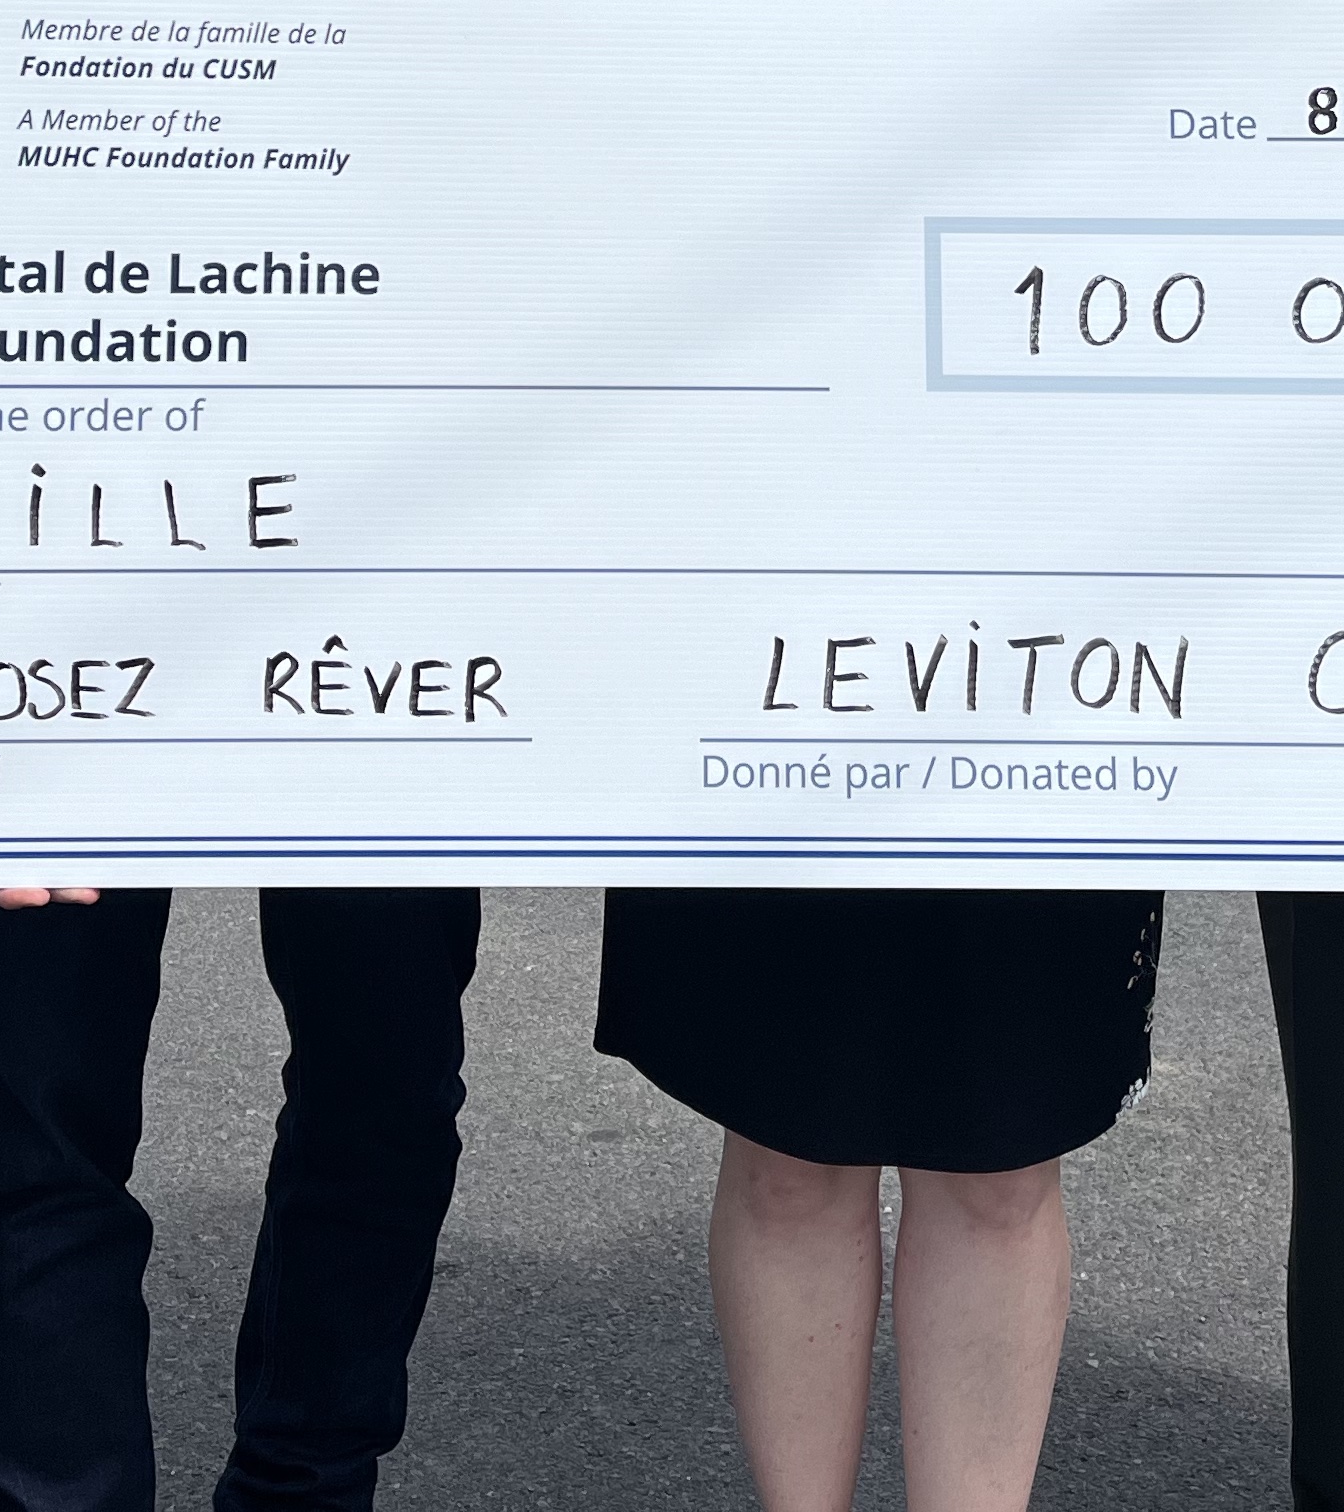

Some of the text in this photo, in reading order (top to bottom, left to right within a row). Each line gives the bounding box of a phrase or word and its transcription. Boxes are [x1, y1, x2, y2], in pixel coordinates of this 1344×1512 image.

[21, 18, 347, 49] Membre de la famille de la
[20, 55, 277, 80] Fondation du CUSM
[16, 108, 222, 138] A Member of the
[1169, 108, 1257, 140] Date
[1308, 86, 1338, 136] 8
[17, 145, 351, 177] MUHC Foundation Family
[84, 250, 150, 294] de
[170, 251, 380, 295] Lachine
[1013, 265, 1206, 356] 100
[43, 397, 153, 432] order
[165, 397, 207, 432] of
[263, 634, 508, 723] RÊVER
[703, 753, 1178, 802] Donné par / Donated by
